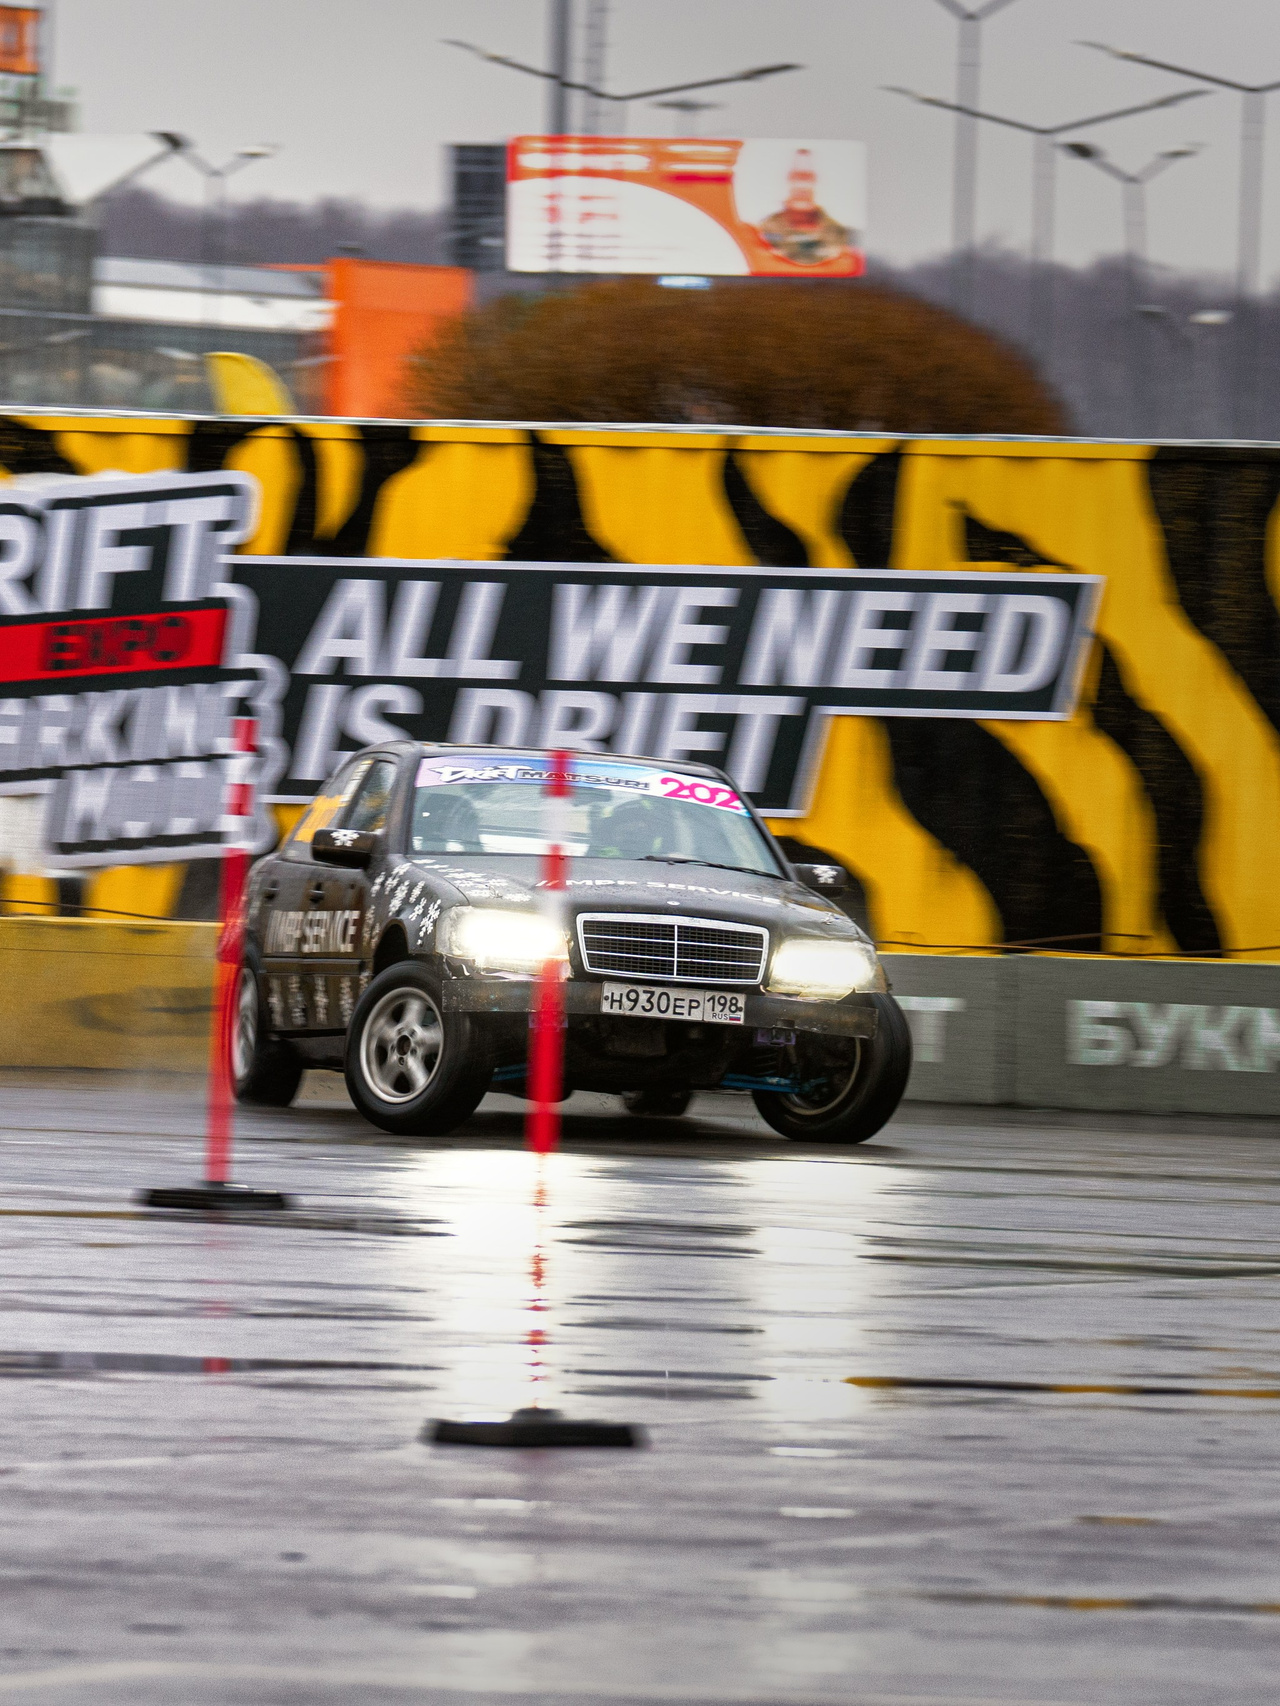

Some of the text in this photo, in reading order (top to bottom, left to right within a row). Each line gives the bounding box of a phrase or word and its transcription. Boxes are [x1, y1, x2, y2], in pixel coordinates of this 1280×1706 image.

[291, 578, 1074, 693] ALL WE NEED
[291, 683, 426, 780] IS
[660, 777, 741, 811] 202
[609, 988, 739, 1017] Н930ЕР 198
[711, 1012, 729, 1021] RUS
